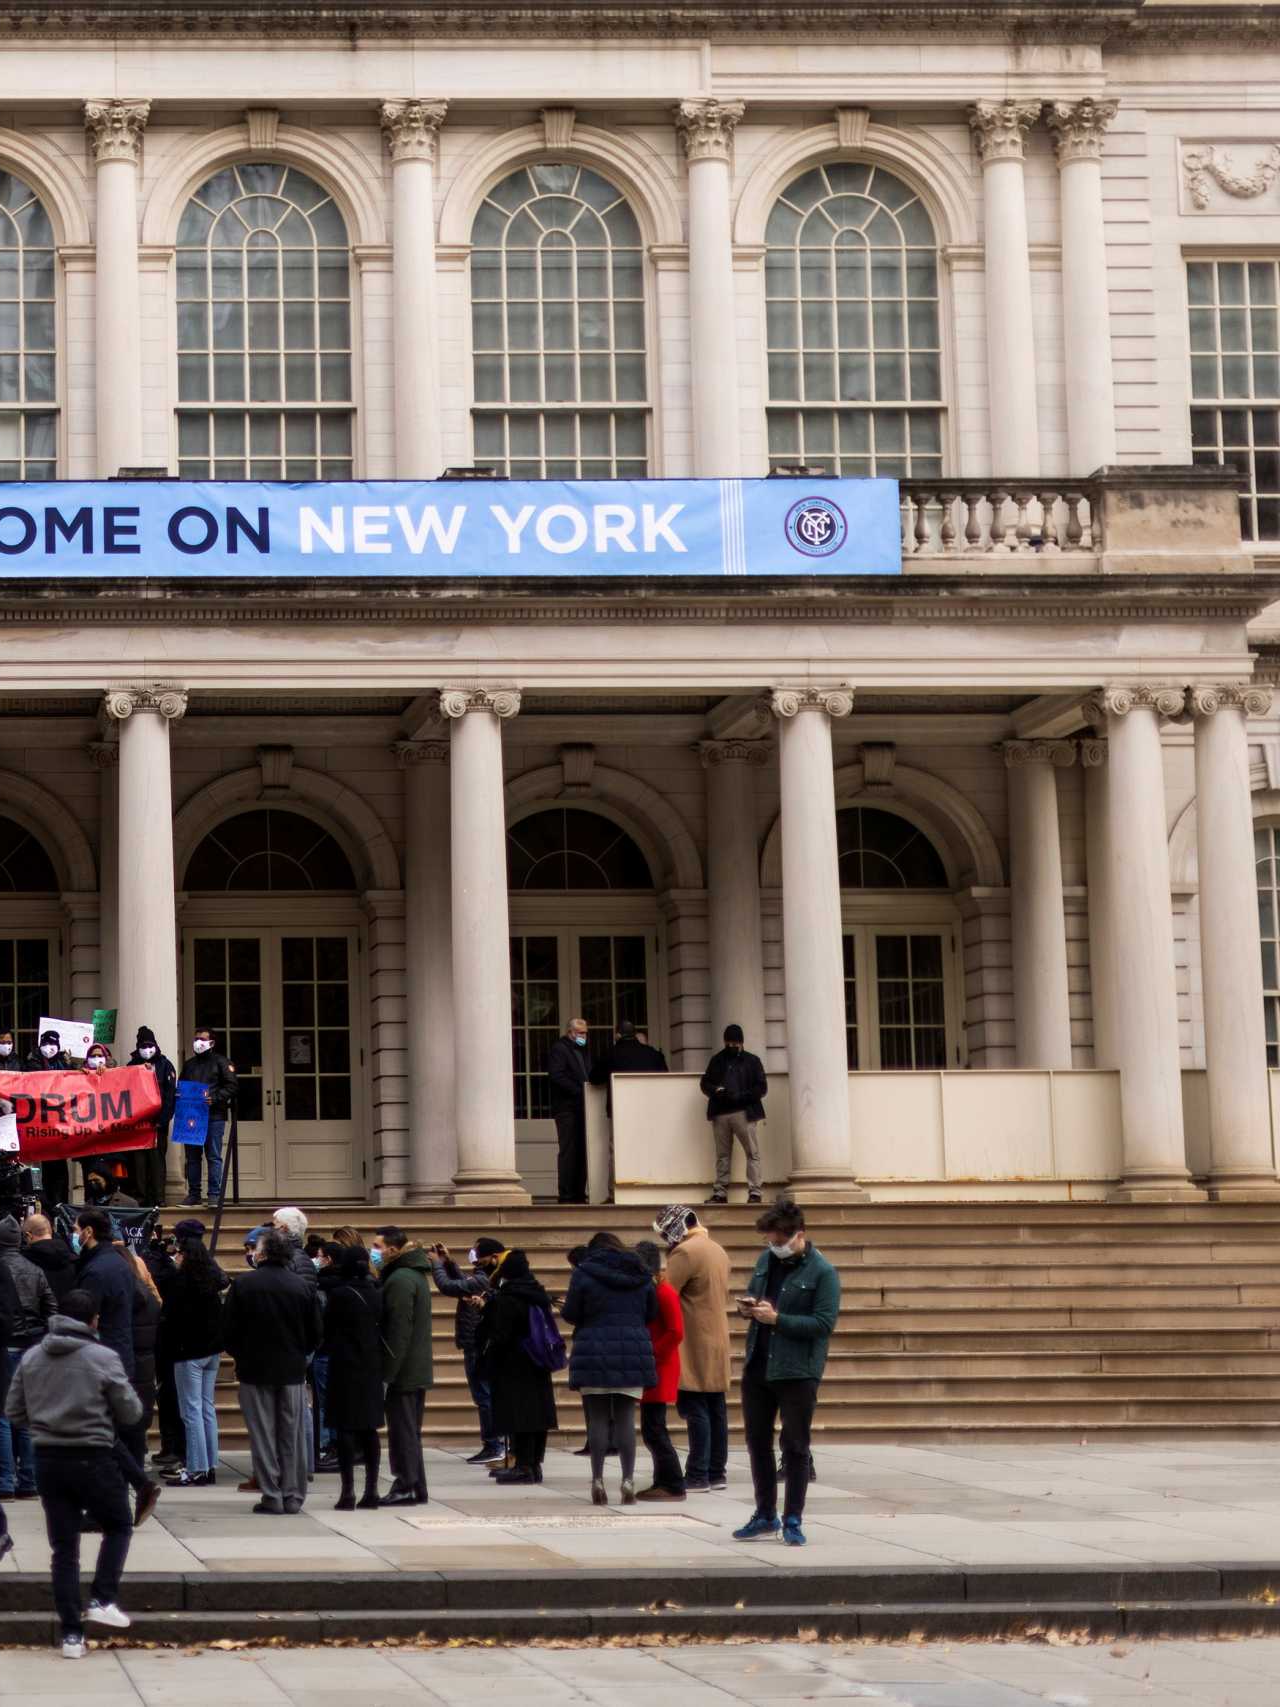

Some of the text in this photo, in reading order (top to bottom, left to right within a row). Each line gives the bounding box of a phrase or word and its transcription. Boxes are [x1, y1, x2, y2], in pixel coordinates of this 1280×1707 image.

[167, 505, 269, 554] ON
[299, 505, 467, 553] NEW
[490, 503, 687, 553] YORK
[10, 1089, 133, 1124] DRUM
[25, 1125, 70, 1140] Rising
[74, 1125, 93, 1139] Up
